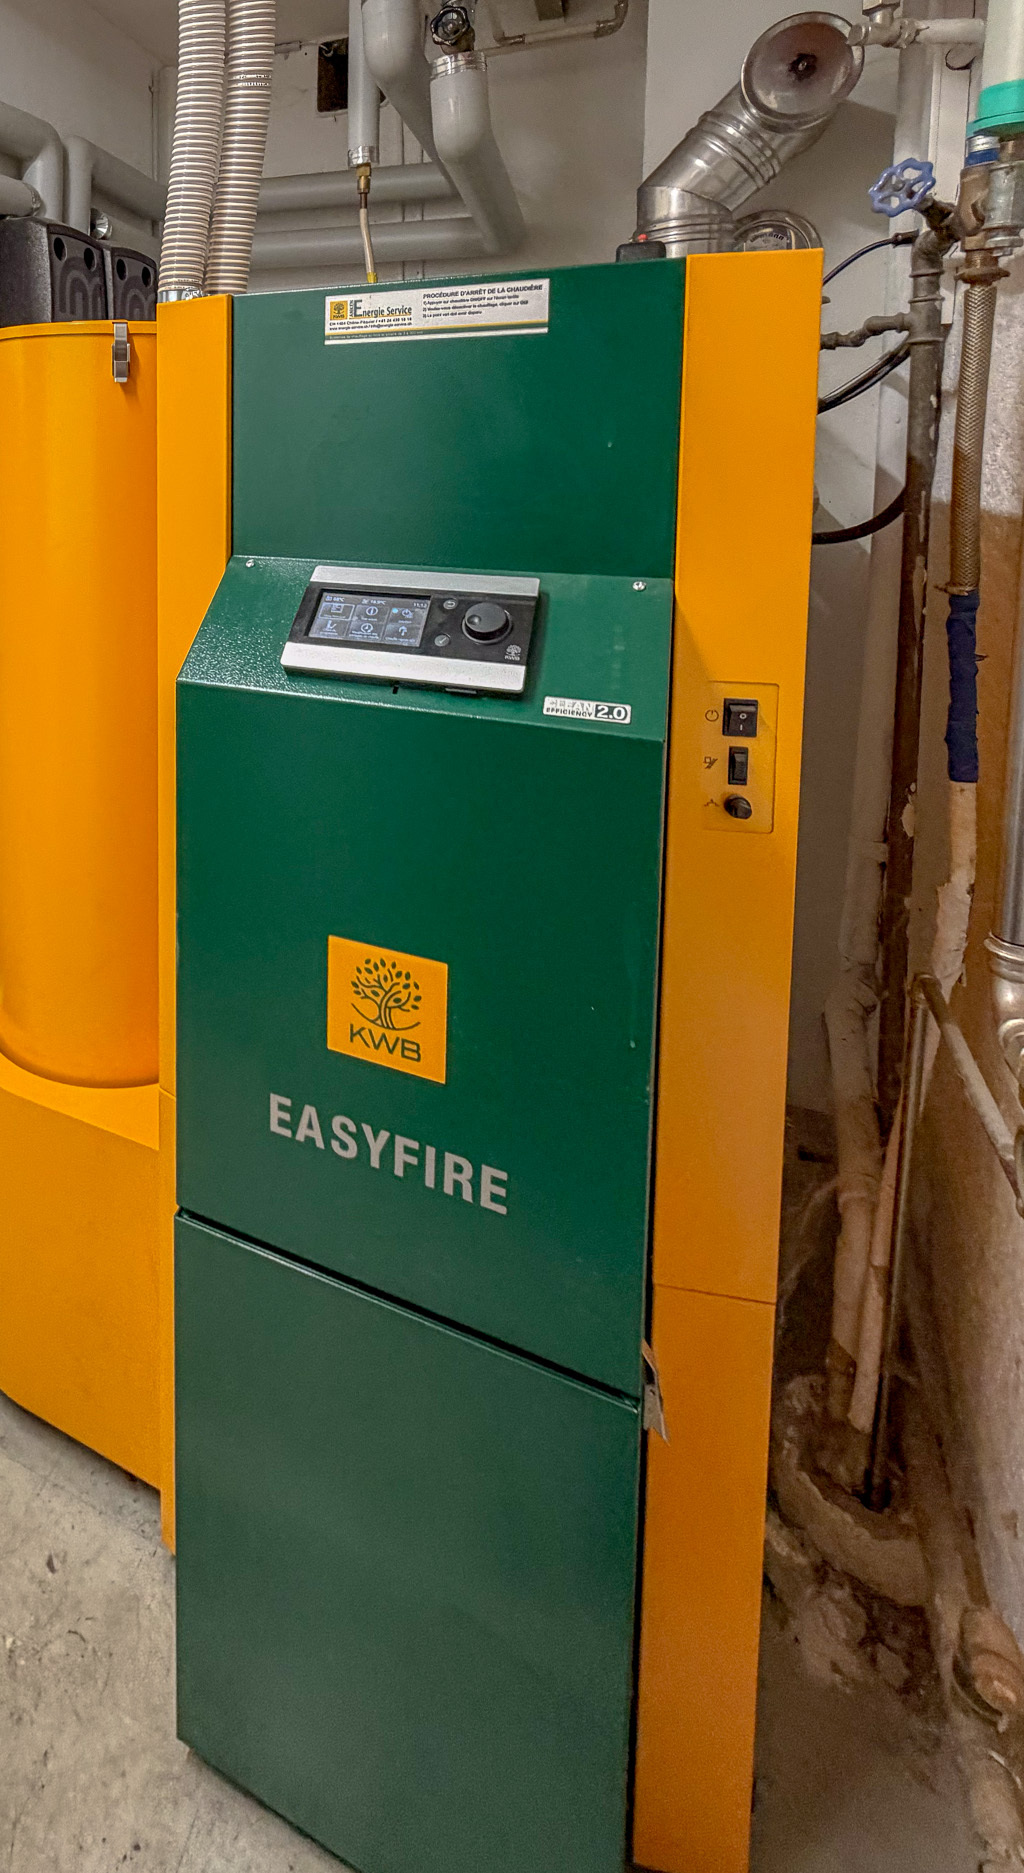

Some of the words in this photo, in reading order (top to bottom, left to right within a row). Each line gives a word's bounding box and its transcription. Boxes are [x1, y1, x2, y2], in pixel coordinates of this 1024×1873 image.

[422, 290, 459, 299] PROCÉDURE
[460, 287, 487, 297] D'ARRÊT
[487, 287, 496, 295] DE
[497, 286, 506, 294] LA
[354, 299, 385, 318] Energie
[386, 305, 412, 316] Service
[546, 706, 593, 718] EFFICIENCY
[596, 705, 627, 720] 2.0
[349, 1023, 421, 1063] KWB
[269, 1092, 508, 1216] EASYFIRE
